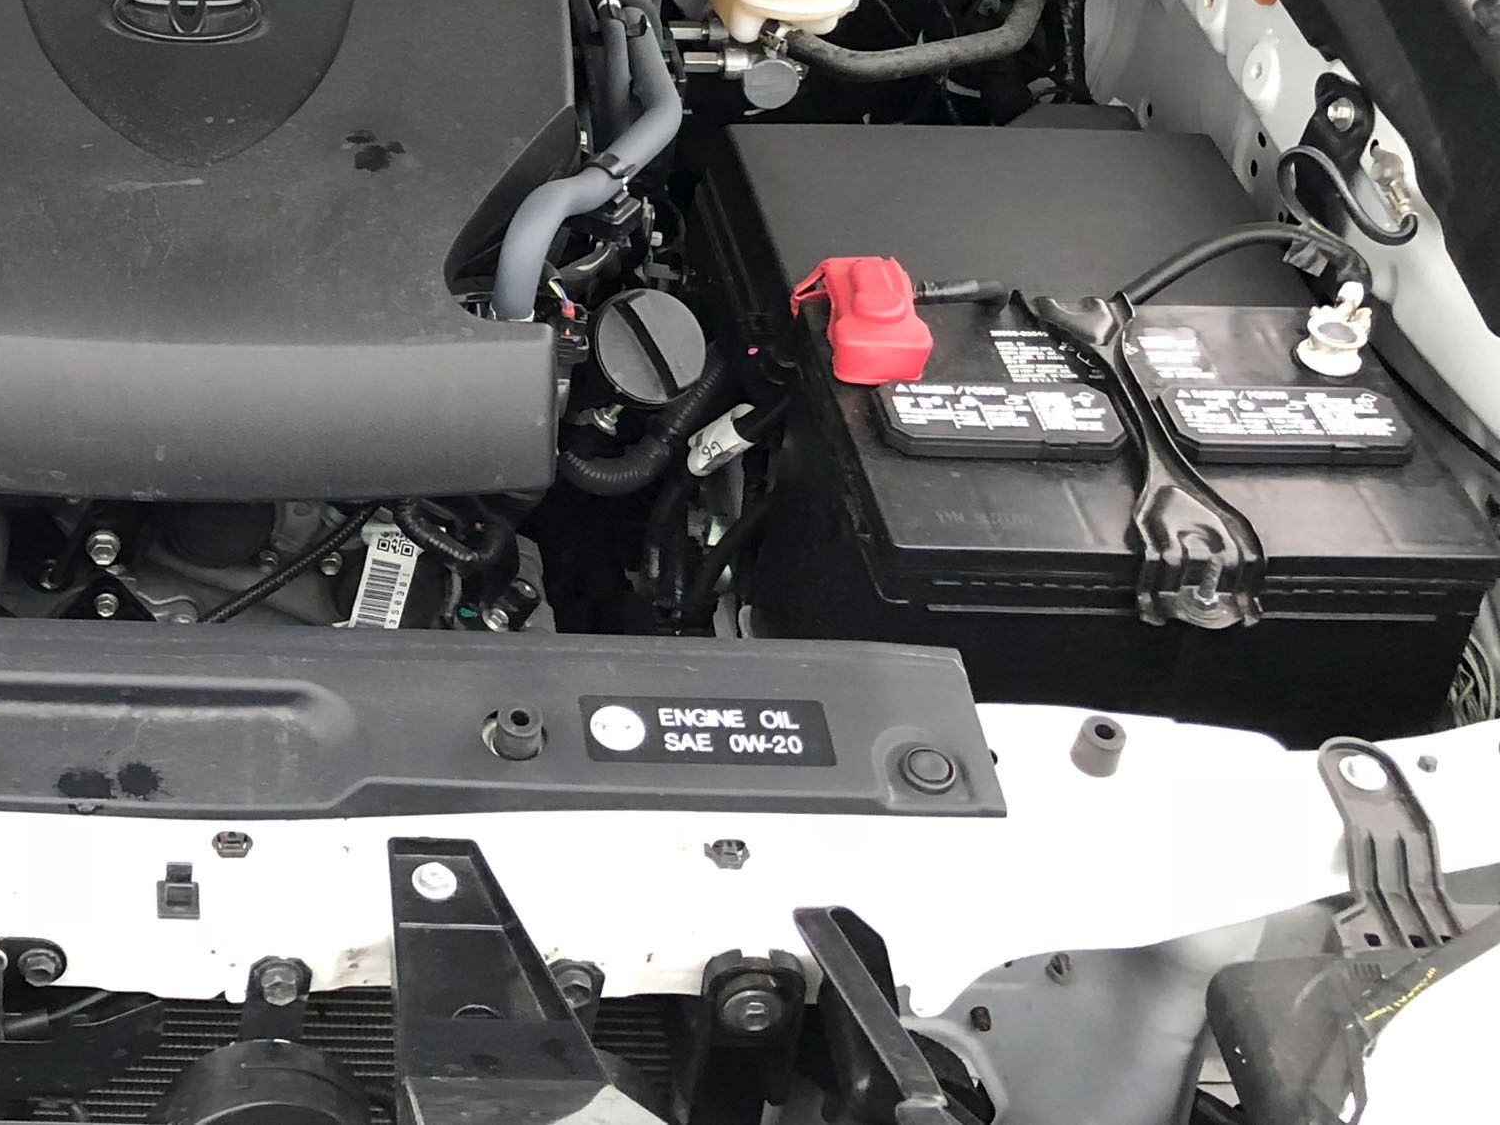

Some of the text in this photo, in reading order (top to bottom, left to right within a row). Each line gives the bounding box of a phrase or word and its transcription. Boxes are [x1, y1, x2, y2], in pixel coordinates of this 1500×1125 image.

[658, 708, 800, 730] ENGINE OIL
[664, 733, 803, 755] SAE 0W-20
